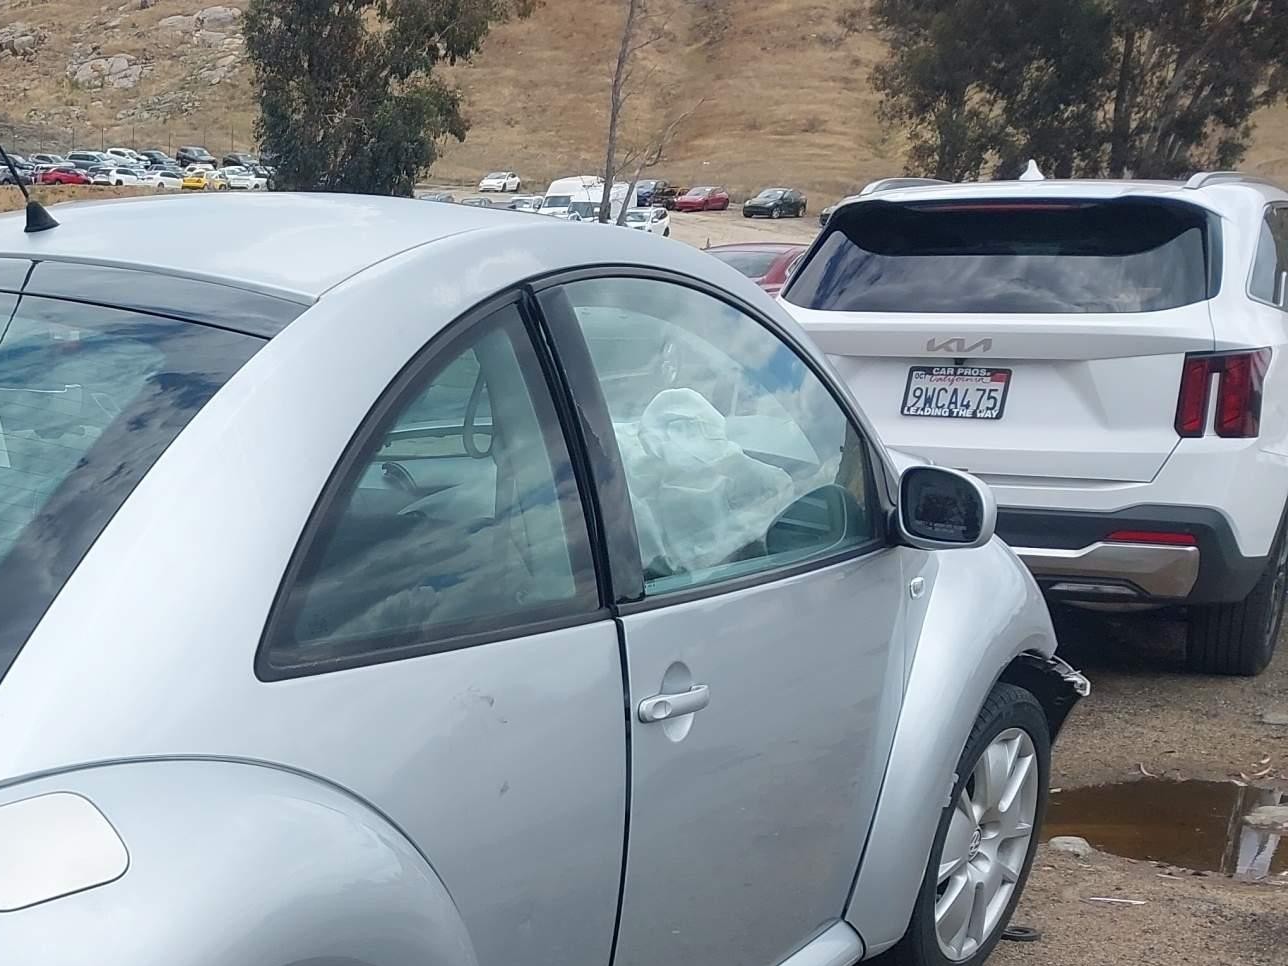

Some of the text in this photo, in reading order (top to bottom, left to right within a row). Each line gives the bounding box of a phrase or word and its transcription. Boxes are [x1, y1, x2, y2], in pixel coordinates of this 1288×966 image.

[926, 336, 993, 352] KIA
[932, 367, 954, 376] CAR
[911, 386, 1000, 412] 9WCA475
[903, 406, 1000, 418] LEADING THE WAY
